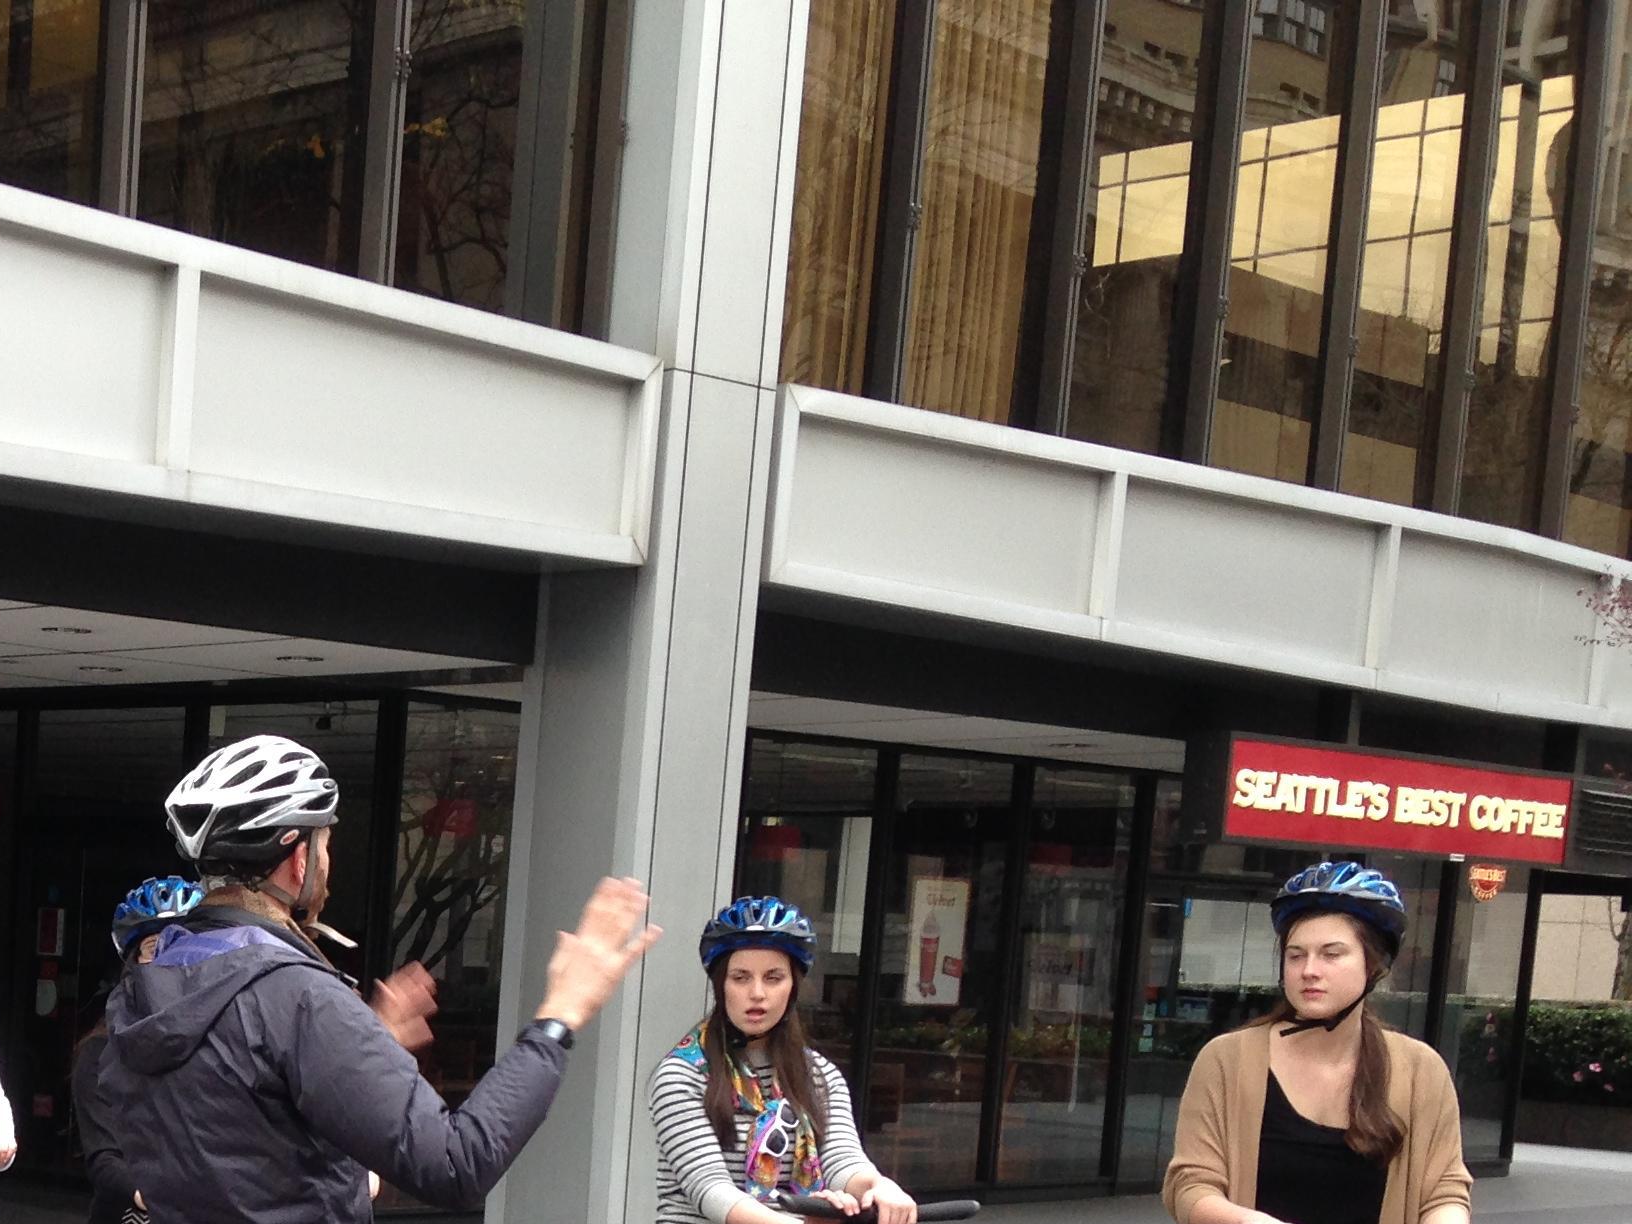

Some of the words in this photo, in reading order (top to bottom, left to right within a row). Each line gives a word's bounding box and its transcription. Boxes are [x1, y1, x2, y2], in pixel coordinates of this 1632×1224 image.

[1232, 768, 1390, 821] SEATTLE'S
[1393, 784, 1467, 829] BEST
[1469, 793, 1567, 839] COFFEE
